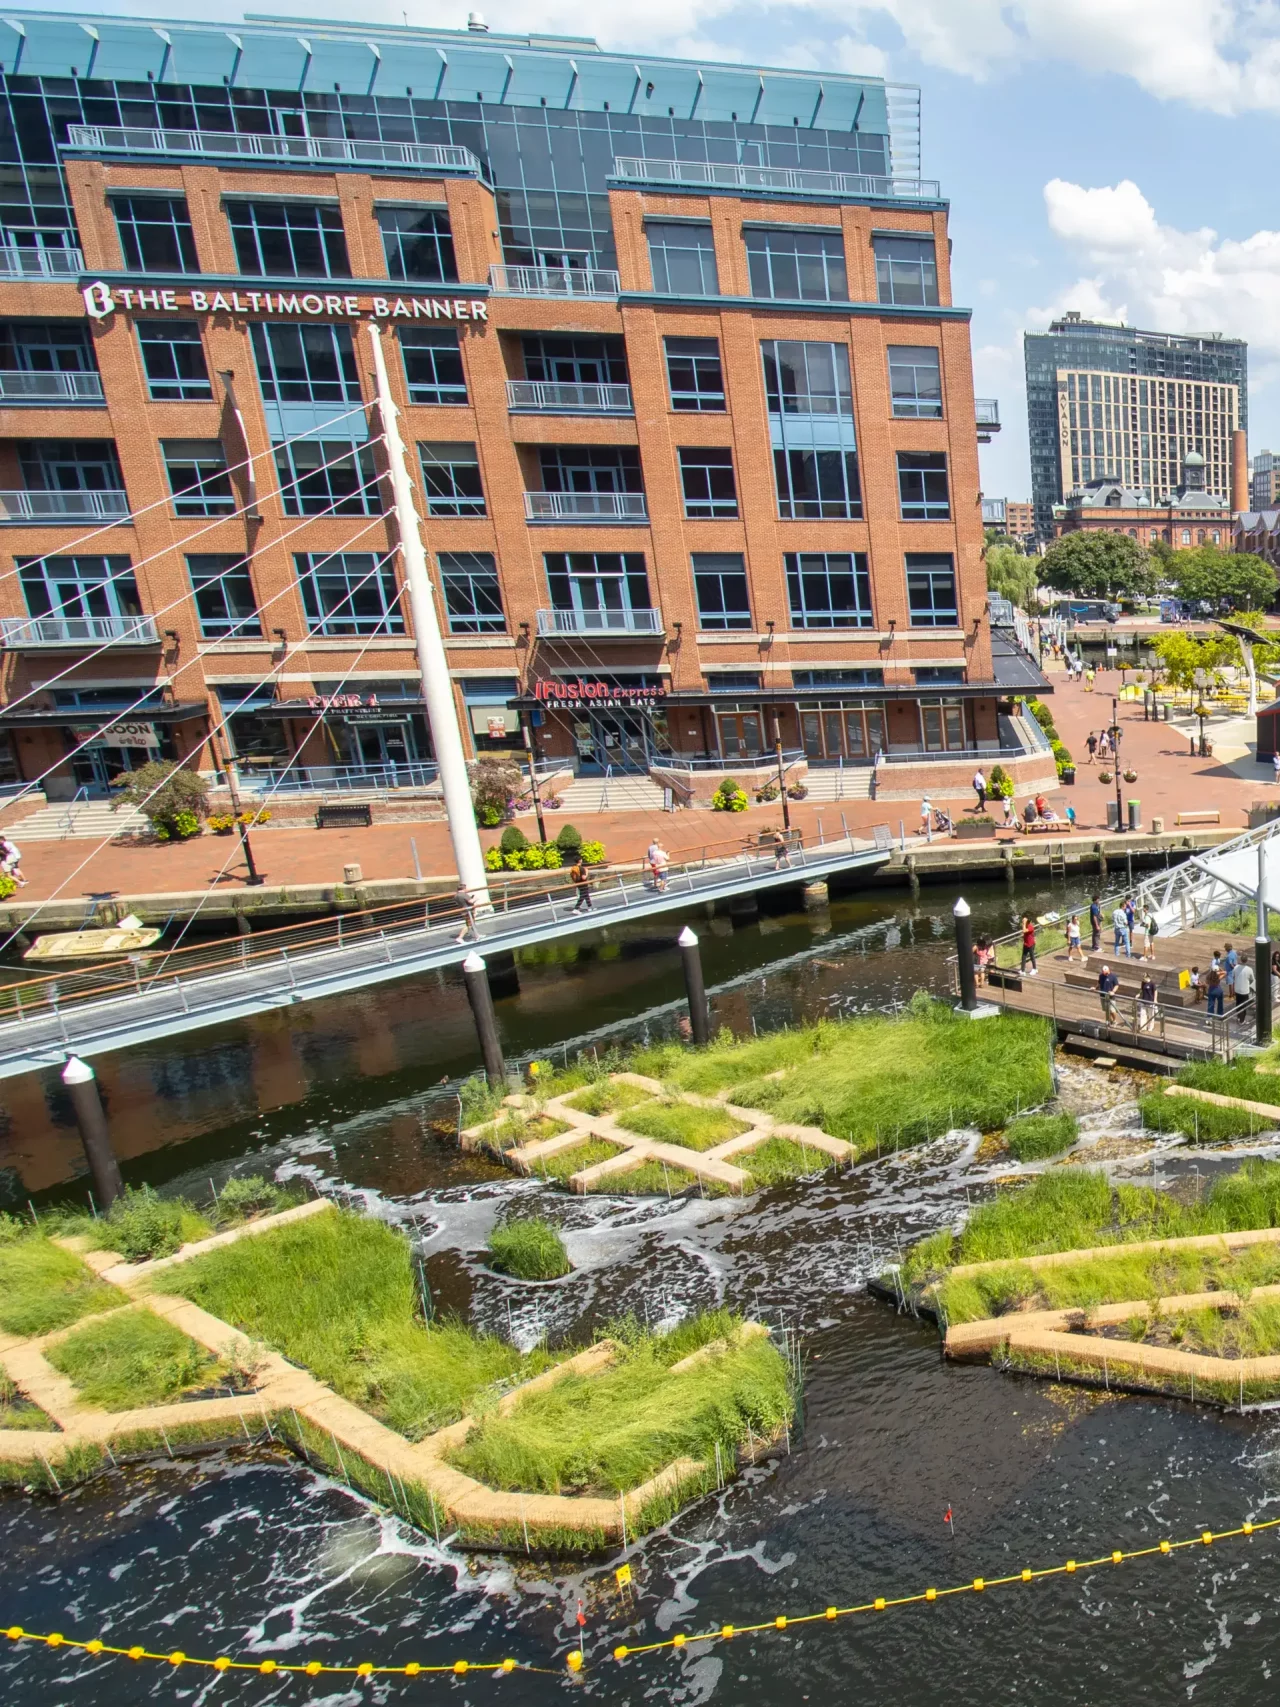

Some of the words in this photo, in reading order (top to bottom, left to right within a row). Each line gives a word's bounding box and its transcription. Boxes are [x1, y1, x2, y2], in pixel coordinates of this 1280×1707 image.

[118, 288, 179, 312] THE
[190, 290, 362, 317] BALTIMORE
[372, 297, 489, 321] BANNER
[1060, 393, 1069, 447] AVALON
[307, 694, 363, 708] PIER
[366, 693, 380, 708] 4
[547, 699, 582, 709] FRESH
[589, 698, 621, 707] ASIAN
[630, 698, 656, 707] EATS
[106, 725, 151, 735] SOON
